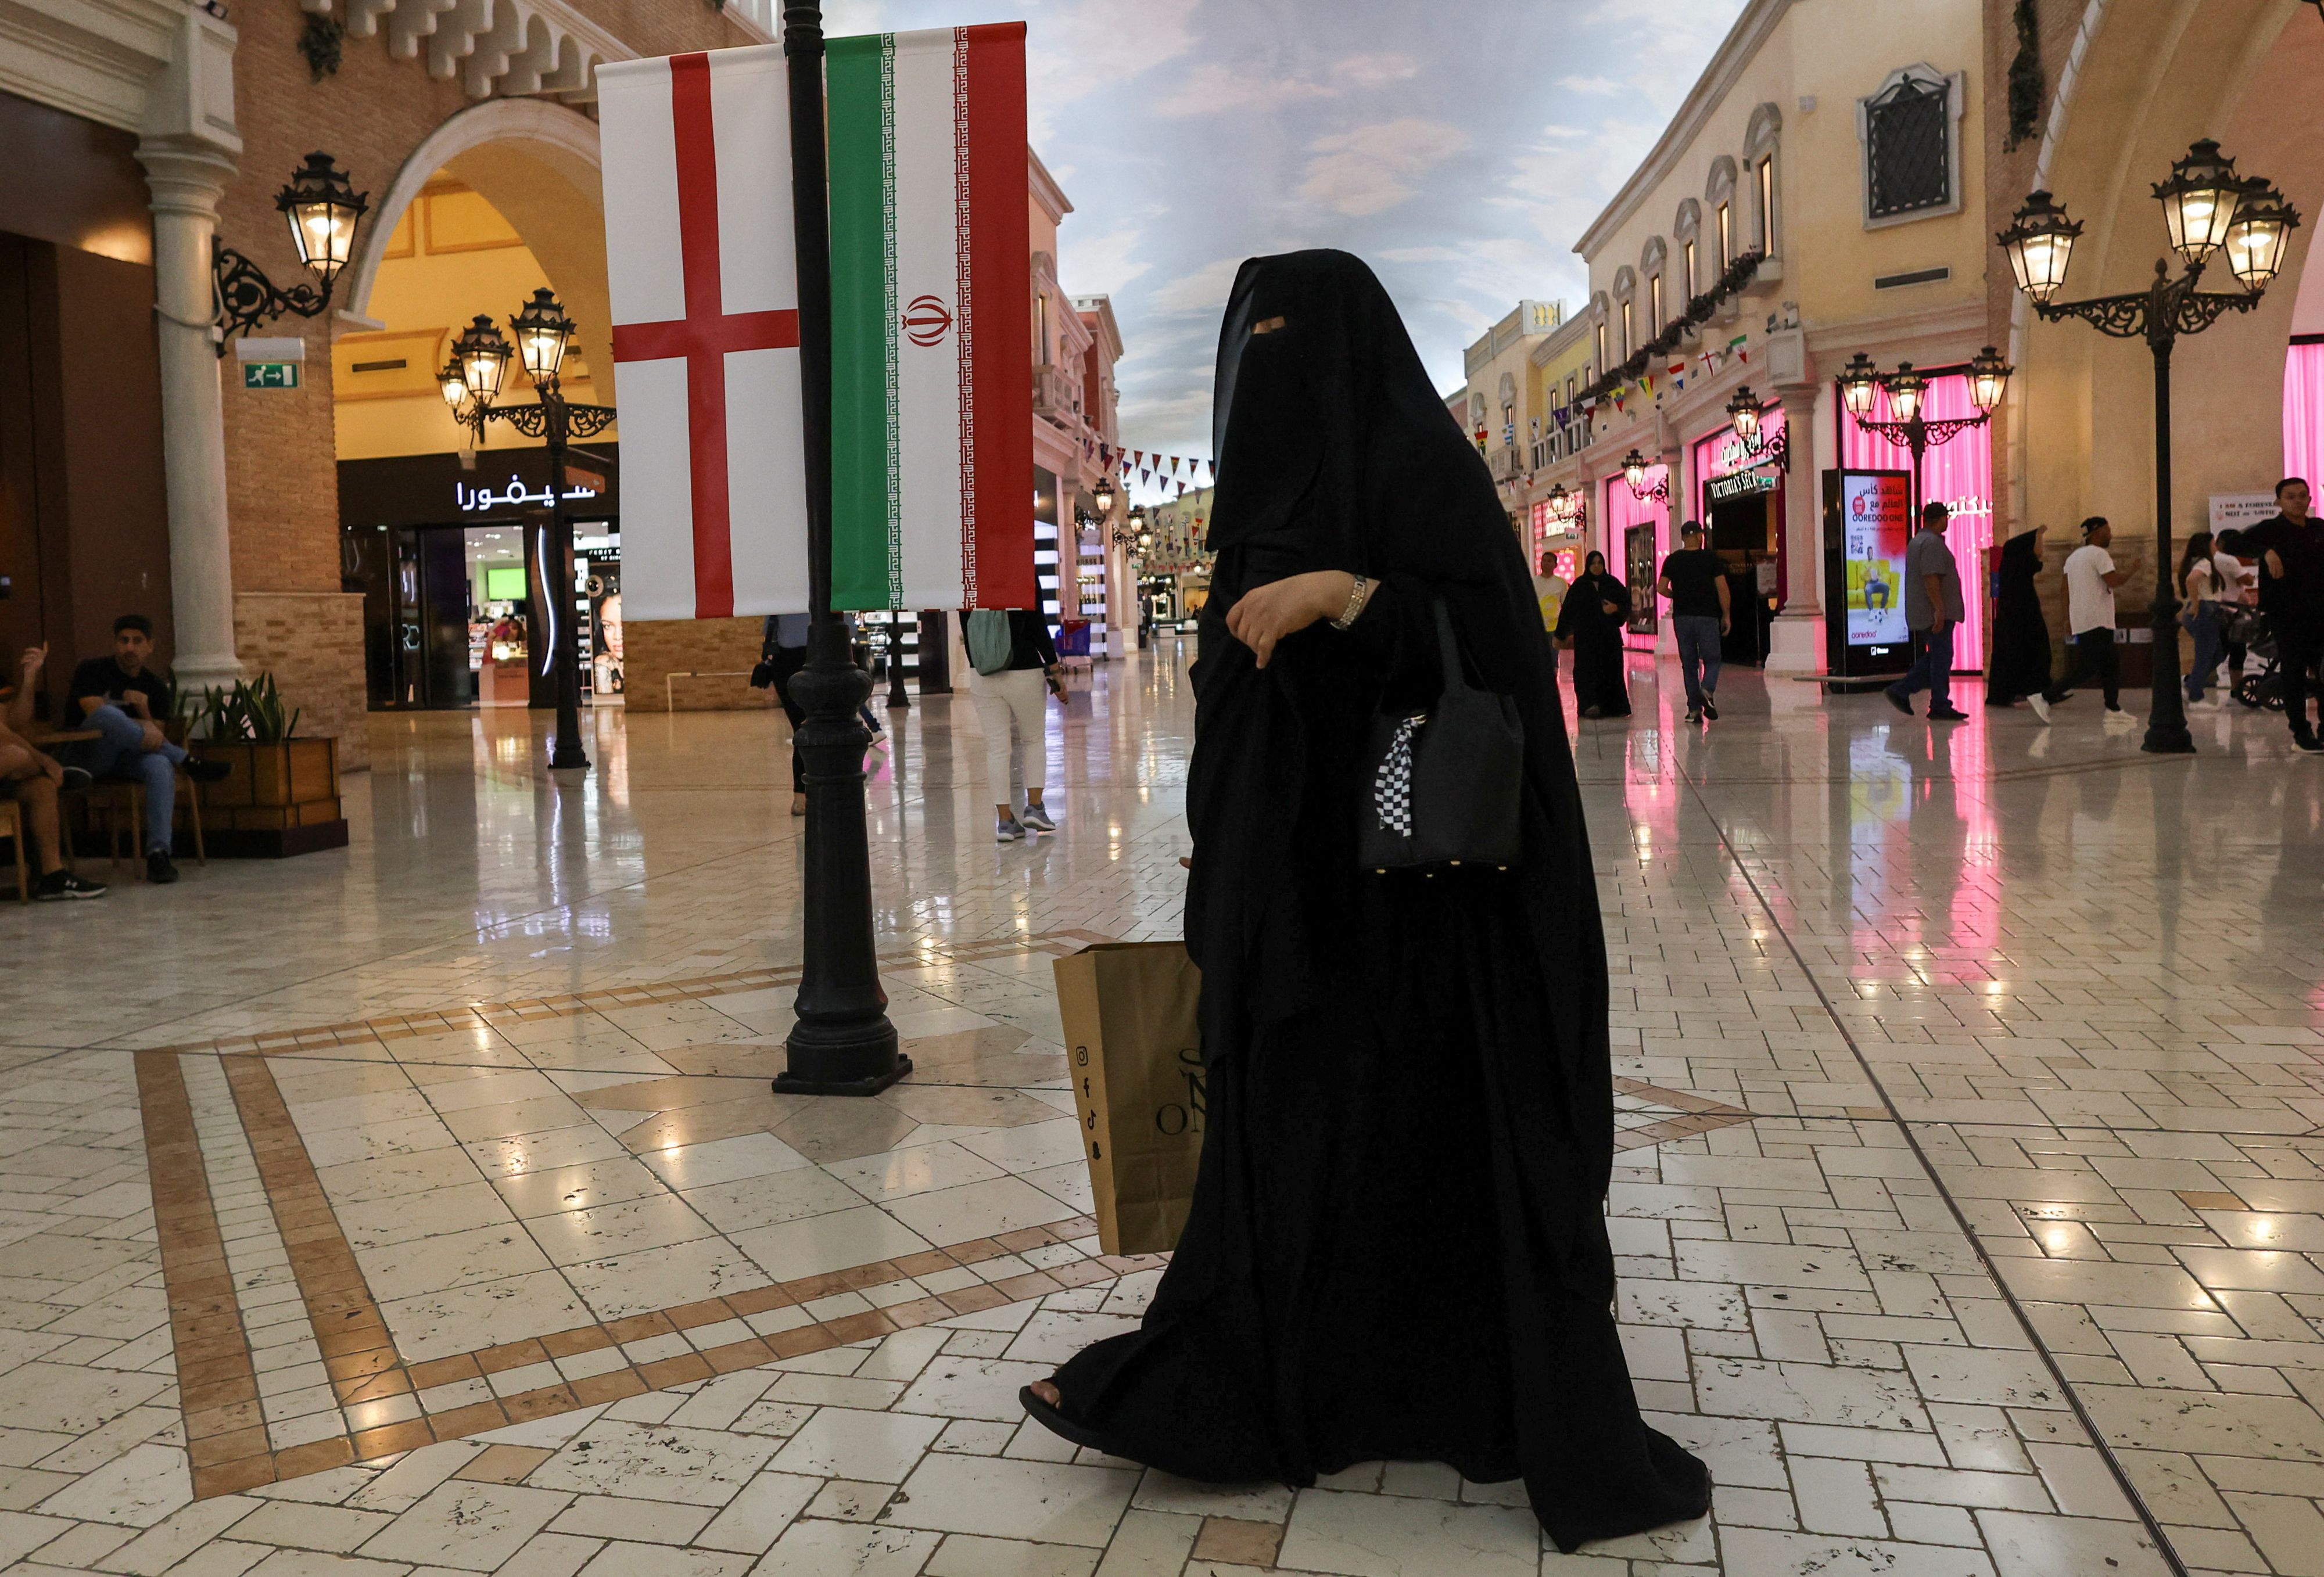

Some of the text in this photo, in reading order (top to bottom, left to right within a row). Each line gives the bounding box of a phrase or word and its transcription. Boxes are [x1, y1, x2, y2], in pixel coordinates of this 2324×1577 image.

[457, 473, 596, 511] سيفورا
[1710, 471, 1758, 499] VICTORIA'S SECR
[1860, 483, 1878, 497] كأس
[1870, 500, 1880, 512] مع
[1852, 513, 1888, 522] OOREDOO
